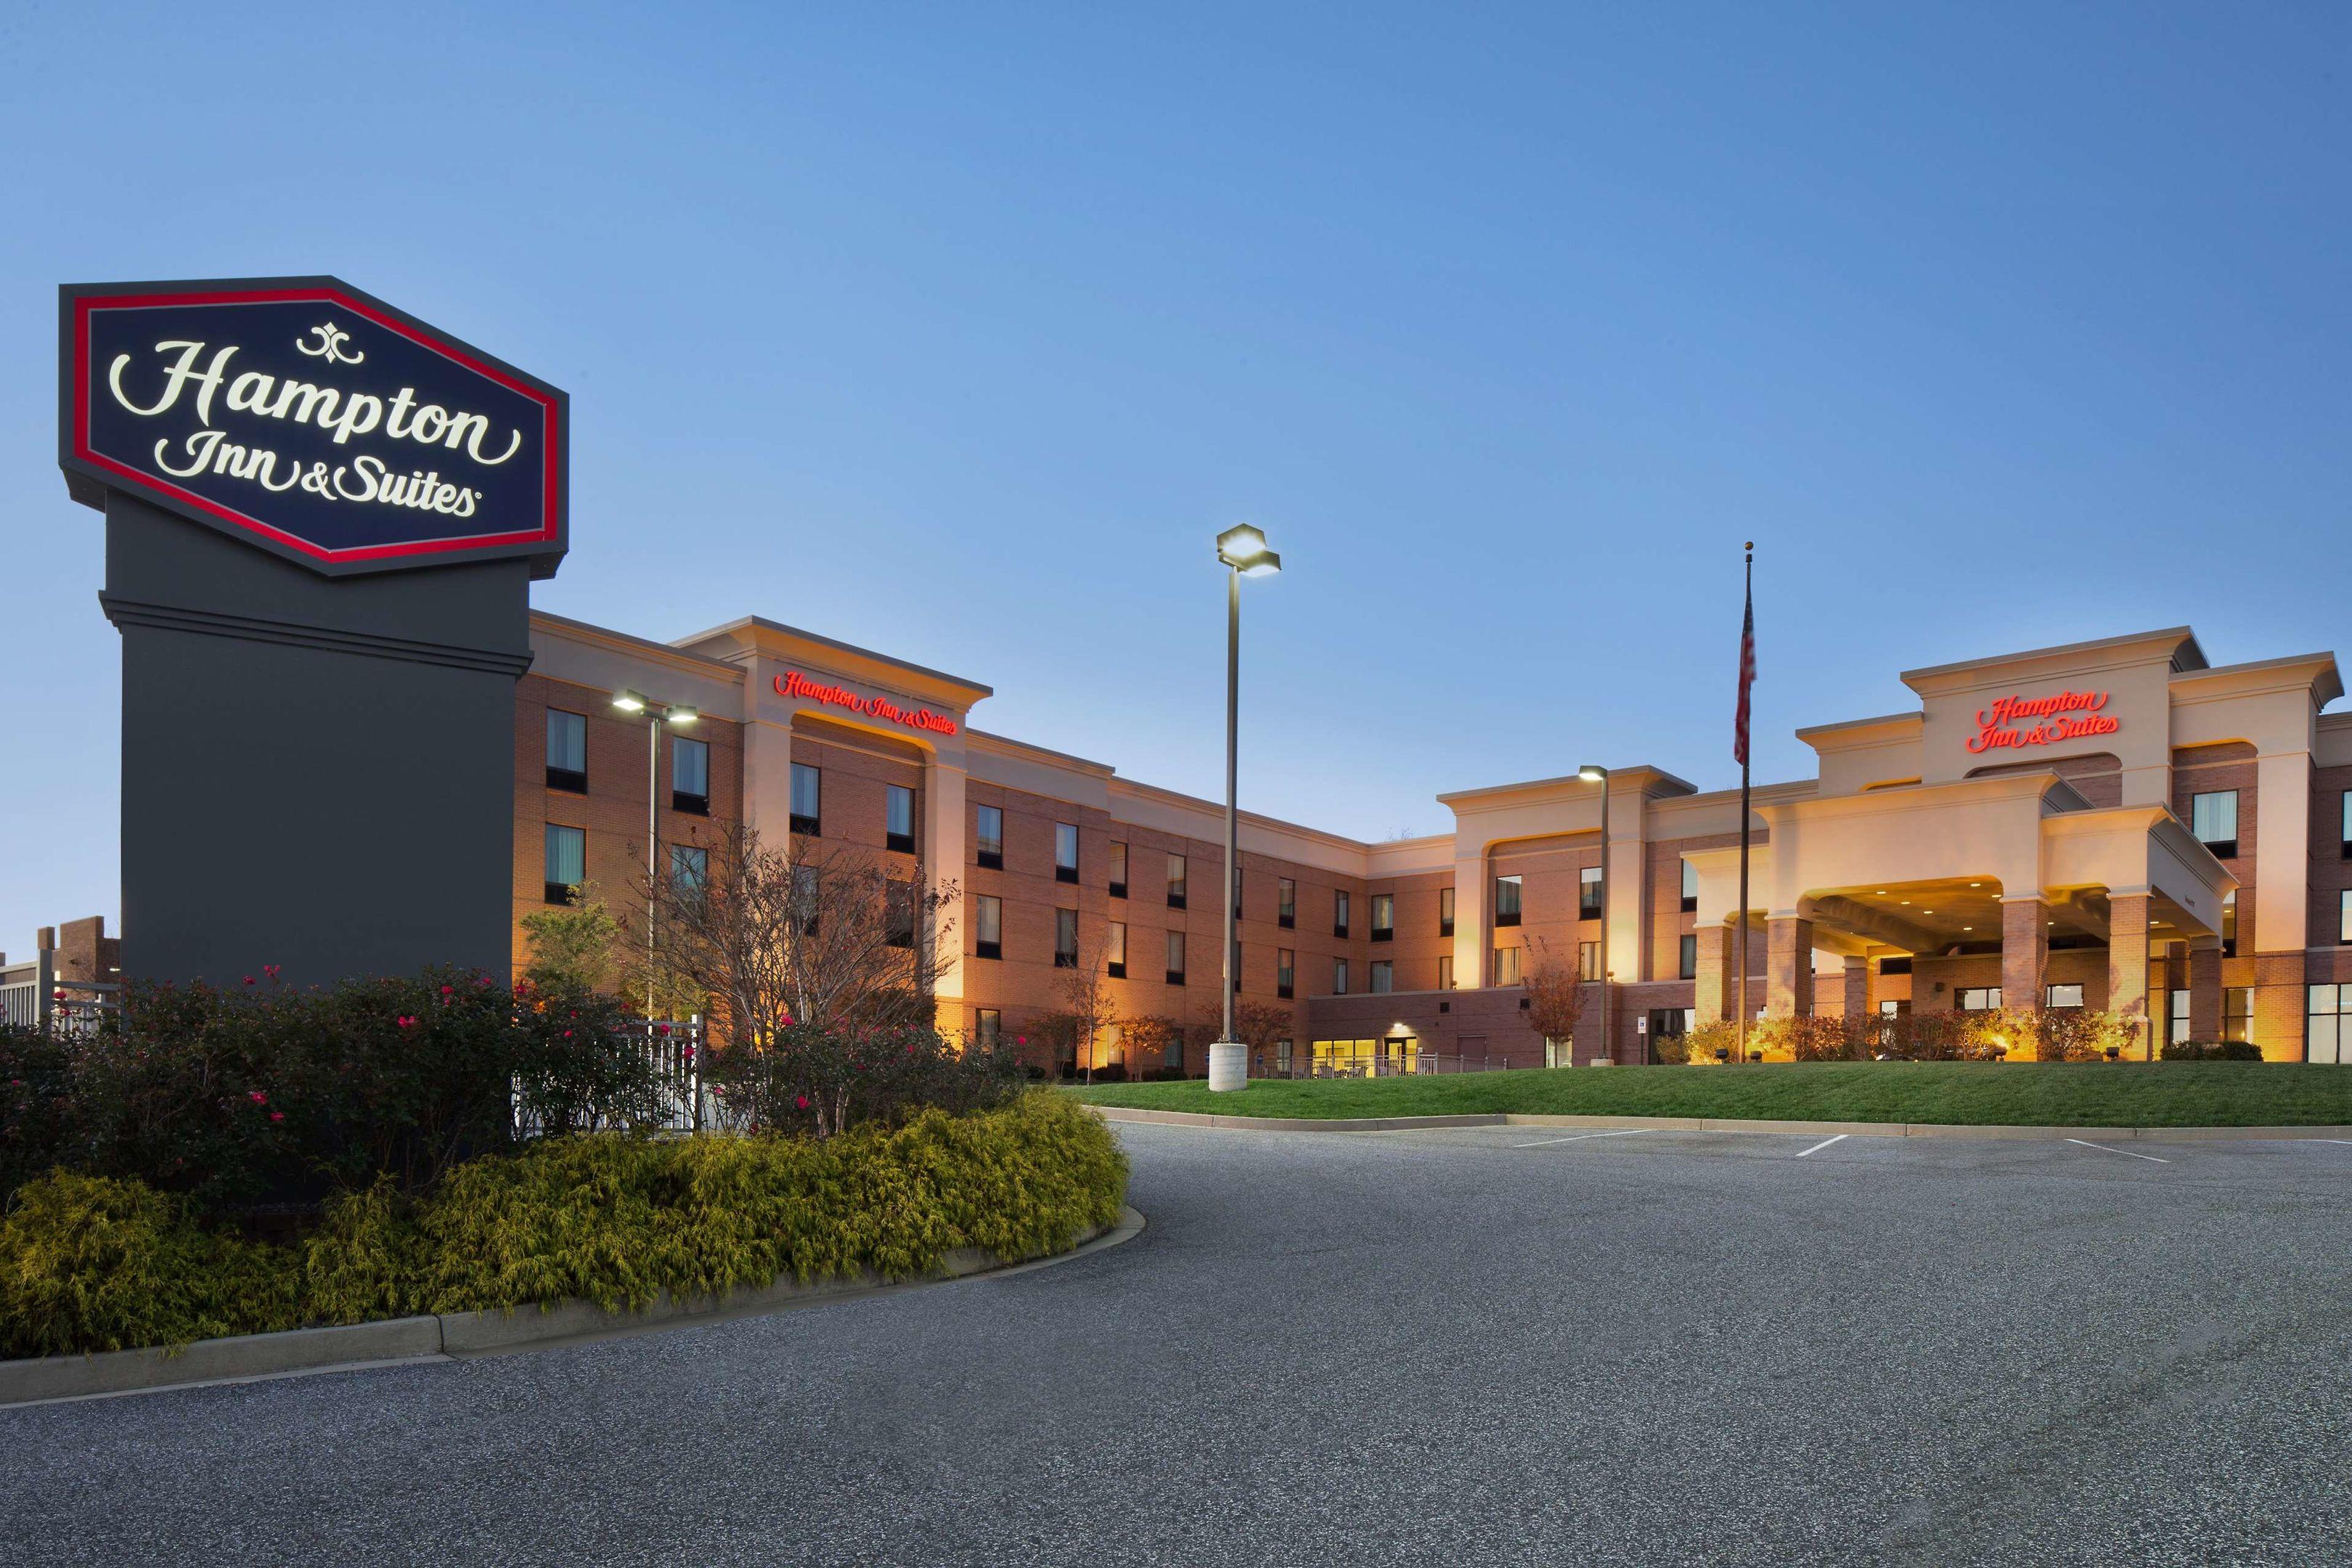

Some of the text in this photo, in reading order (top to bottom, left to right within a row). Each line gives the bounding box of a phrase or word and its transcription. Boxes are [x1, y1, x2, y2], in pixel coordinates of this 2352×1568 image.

[110, 341, 521, 465] Hampton
[155, 431, 476, 518] Inn & Suites
[774, 671, 958, 736] Hampton Inn & Suites
[1966, 714, 2120, 754] Inn & Suites
[1975, 691, 2108, 729] Hampton
